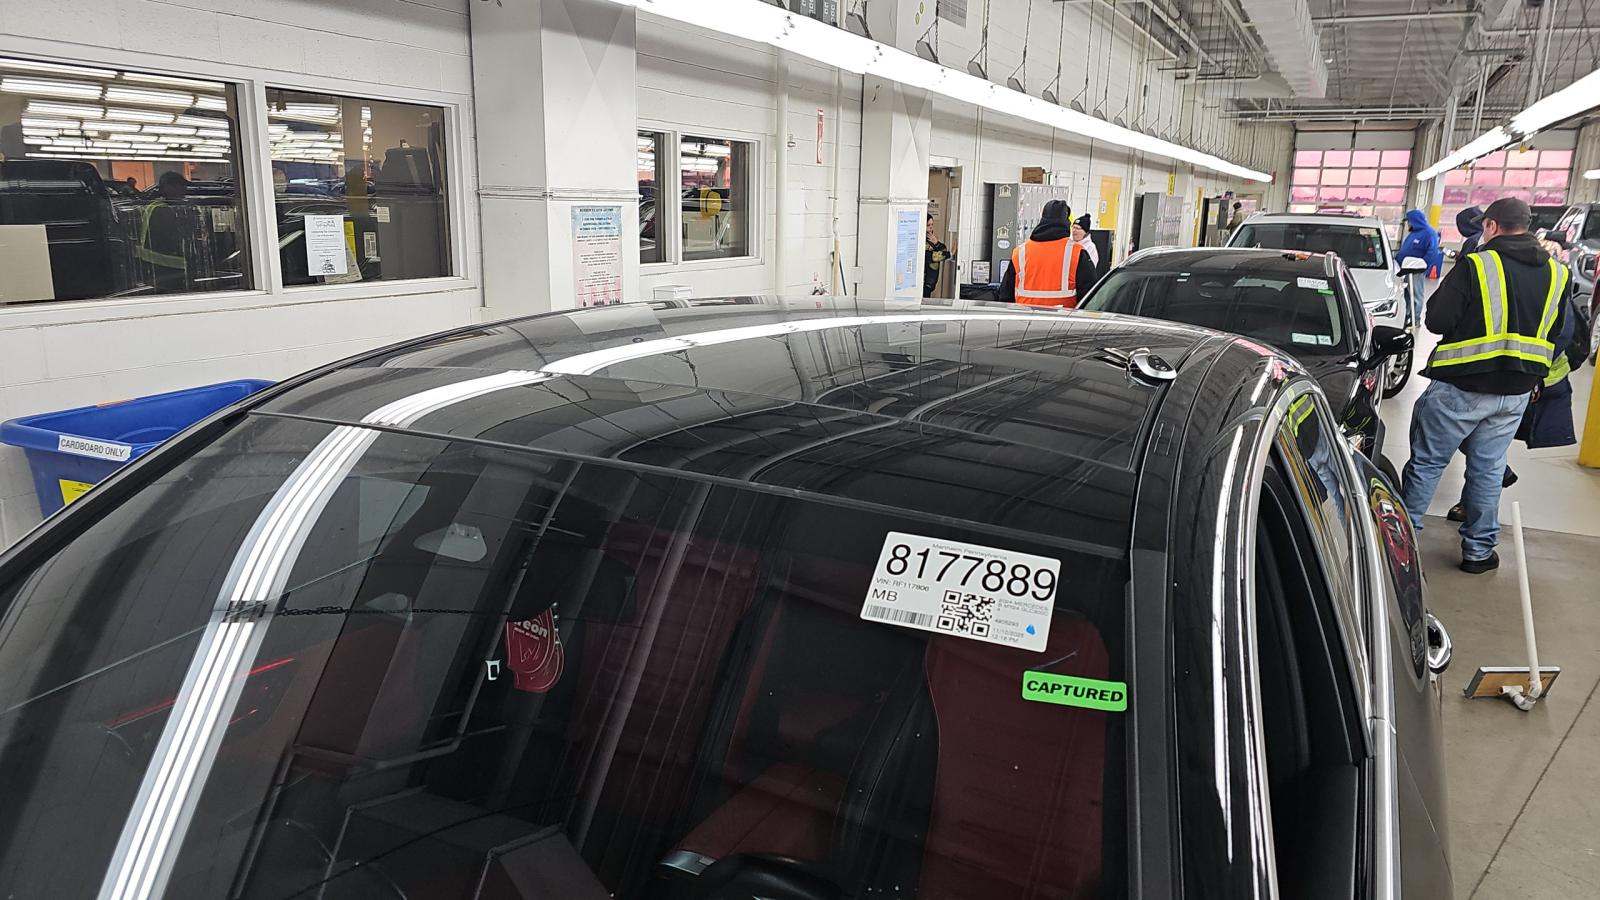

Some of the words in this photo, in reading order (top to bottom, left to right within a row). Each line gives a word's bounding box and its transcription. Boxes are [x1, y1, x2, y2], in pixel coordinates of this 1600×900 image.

[61, 438, 103, 454] CARDBOARD
[105, 446, 125, 457] ONLY
[875, 577, 891, 585] VIN:
[886, 544, 1056, 601] 8177889
[871, 588, 898, 602] MB
[1026, 680, 1124, 702] CAPTURED
